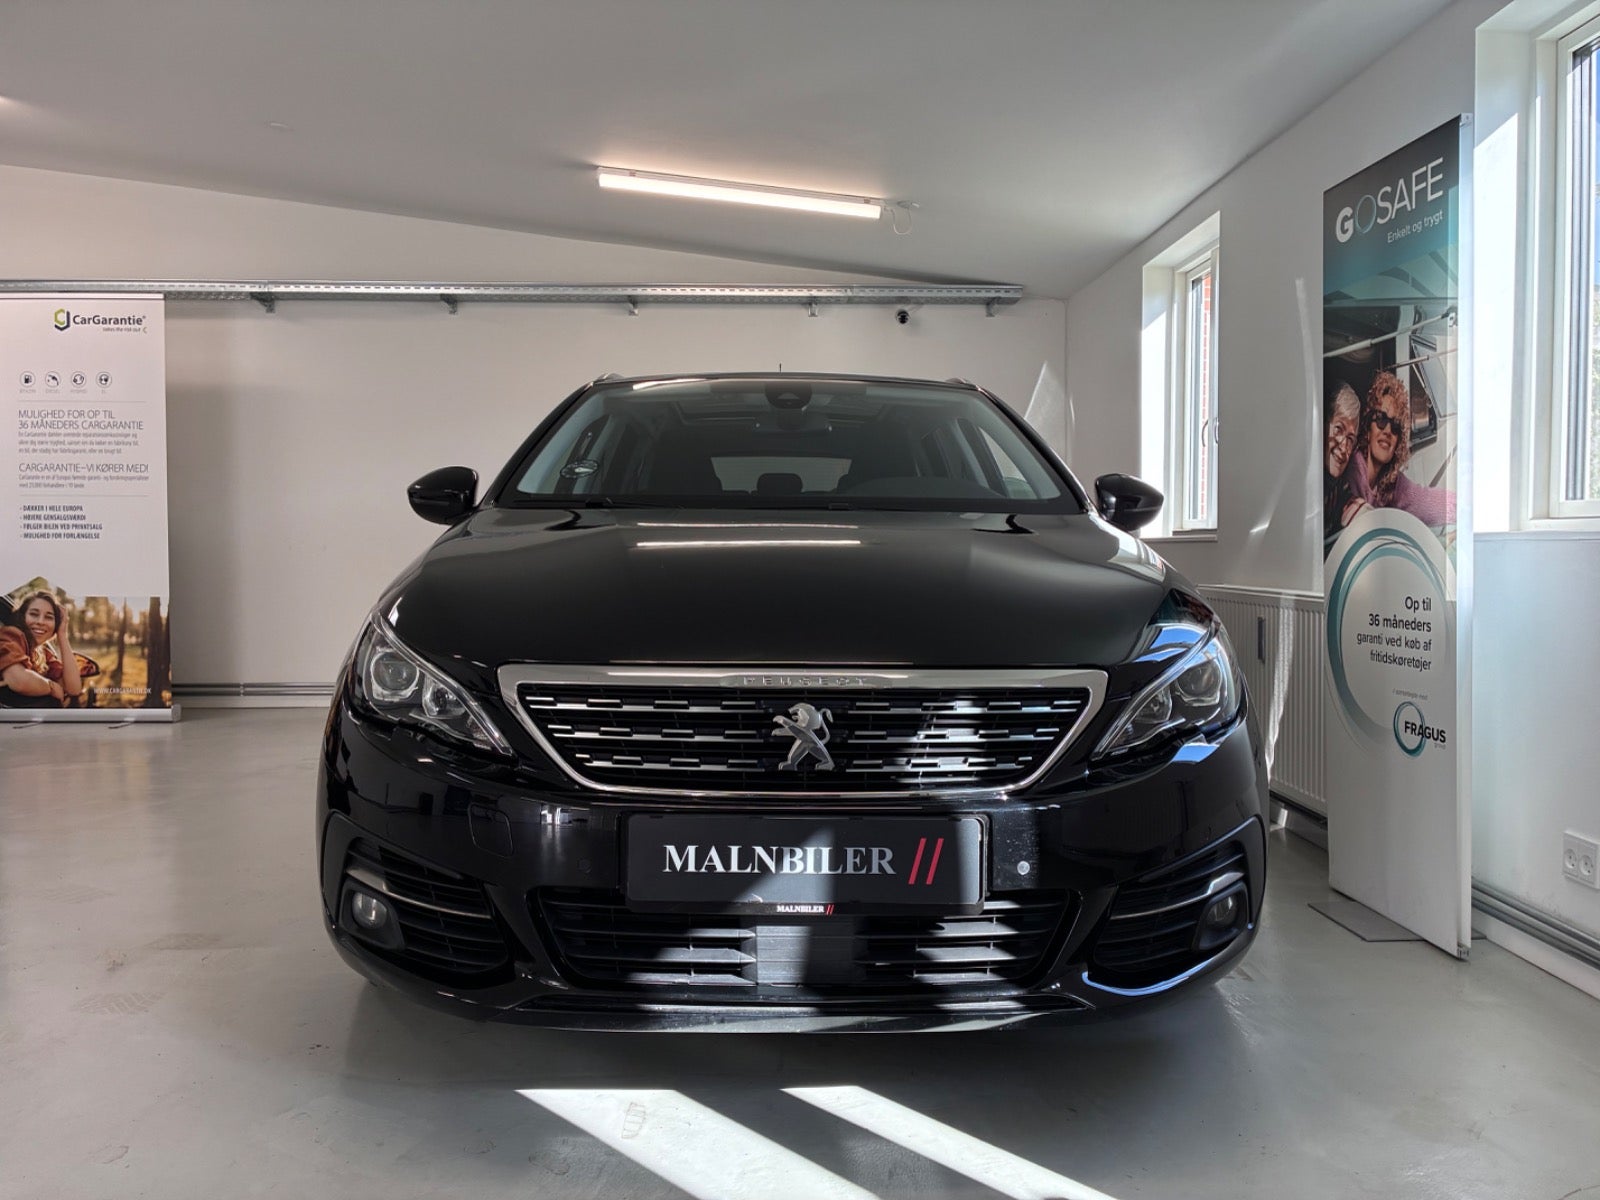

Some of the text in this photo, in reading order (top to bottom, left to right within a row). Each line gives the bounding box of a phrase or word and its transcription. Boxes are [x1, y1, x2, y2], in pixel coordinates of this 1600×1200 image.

[1335, 157, 1443, 243] GOSAFE
[1387, 210, 1443, 243] Enkelt og trygt
[18, 409, 115, 419] MULIGHED FOR OP TIL
[18, 419, 144, 430] 36 MÅNEDERS CARGARANTIE
[95, 464, 125, 473] KØRER
[1404, 596, 1432, 613] Op til
[1368, 613, 1432, 632] 36 måneders
[1356, 632, 1432, 652] garanti ved køb af
[1370, 650, 1432, 672] fritidskøretøjer
[1404, 720, 1447, 743] FRAGUS
[662, 844, 897, 875] MALNBILER
[776, 904, 825, 913] MALNBILER
